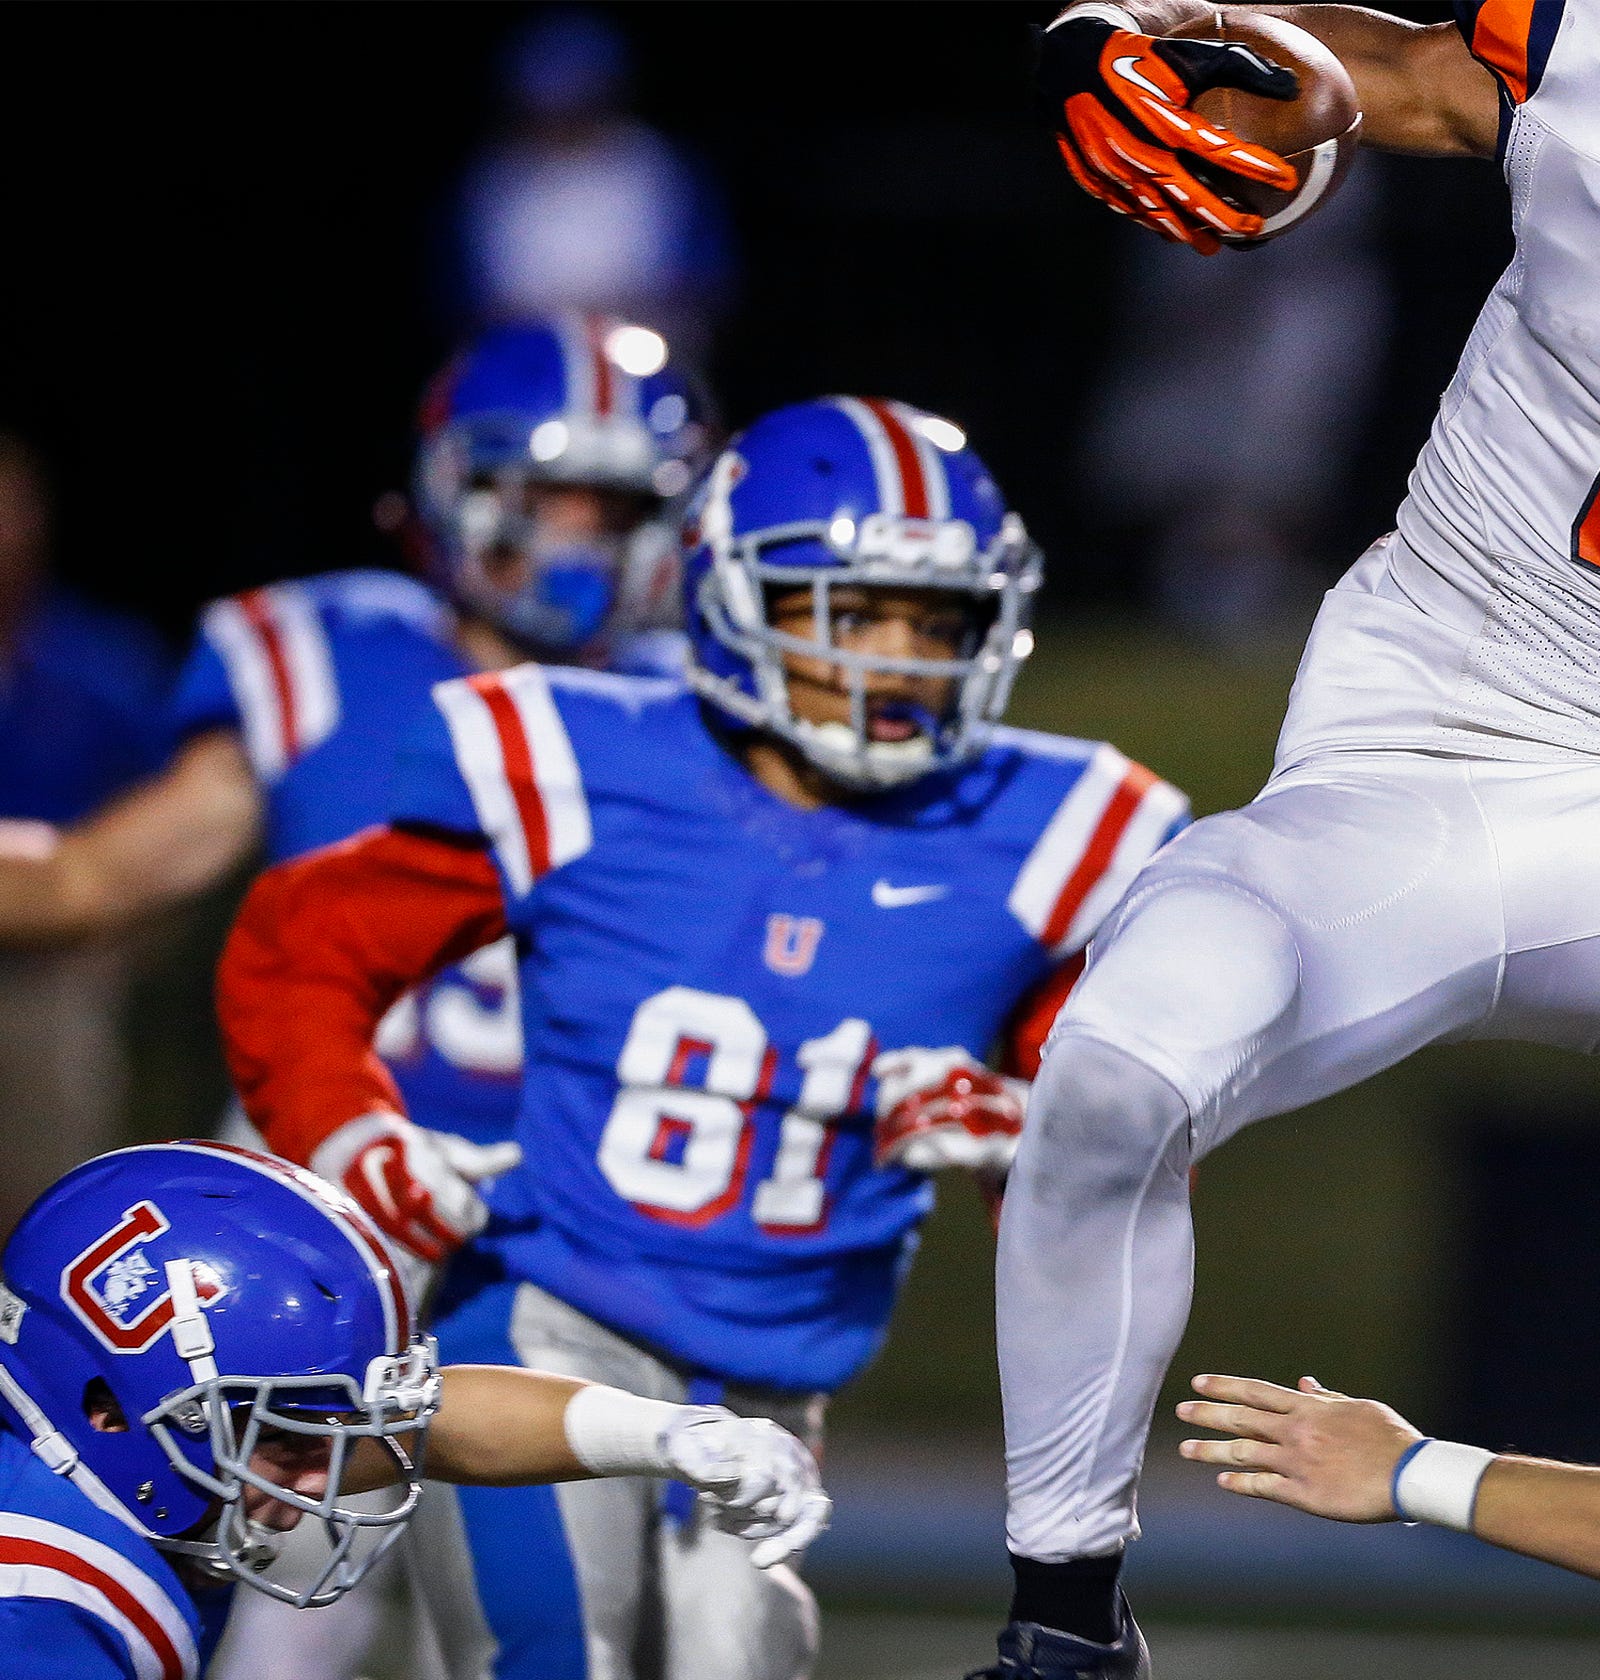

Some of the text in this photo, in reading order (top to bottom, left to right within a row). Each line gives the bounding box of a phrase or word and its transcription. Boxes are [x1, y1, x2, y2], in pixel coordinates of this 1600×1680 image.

[764, 914, 824, 976] U
[597, 985, 881, 1237] 81
[60, 1200, 230, 1354] U
